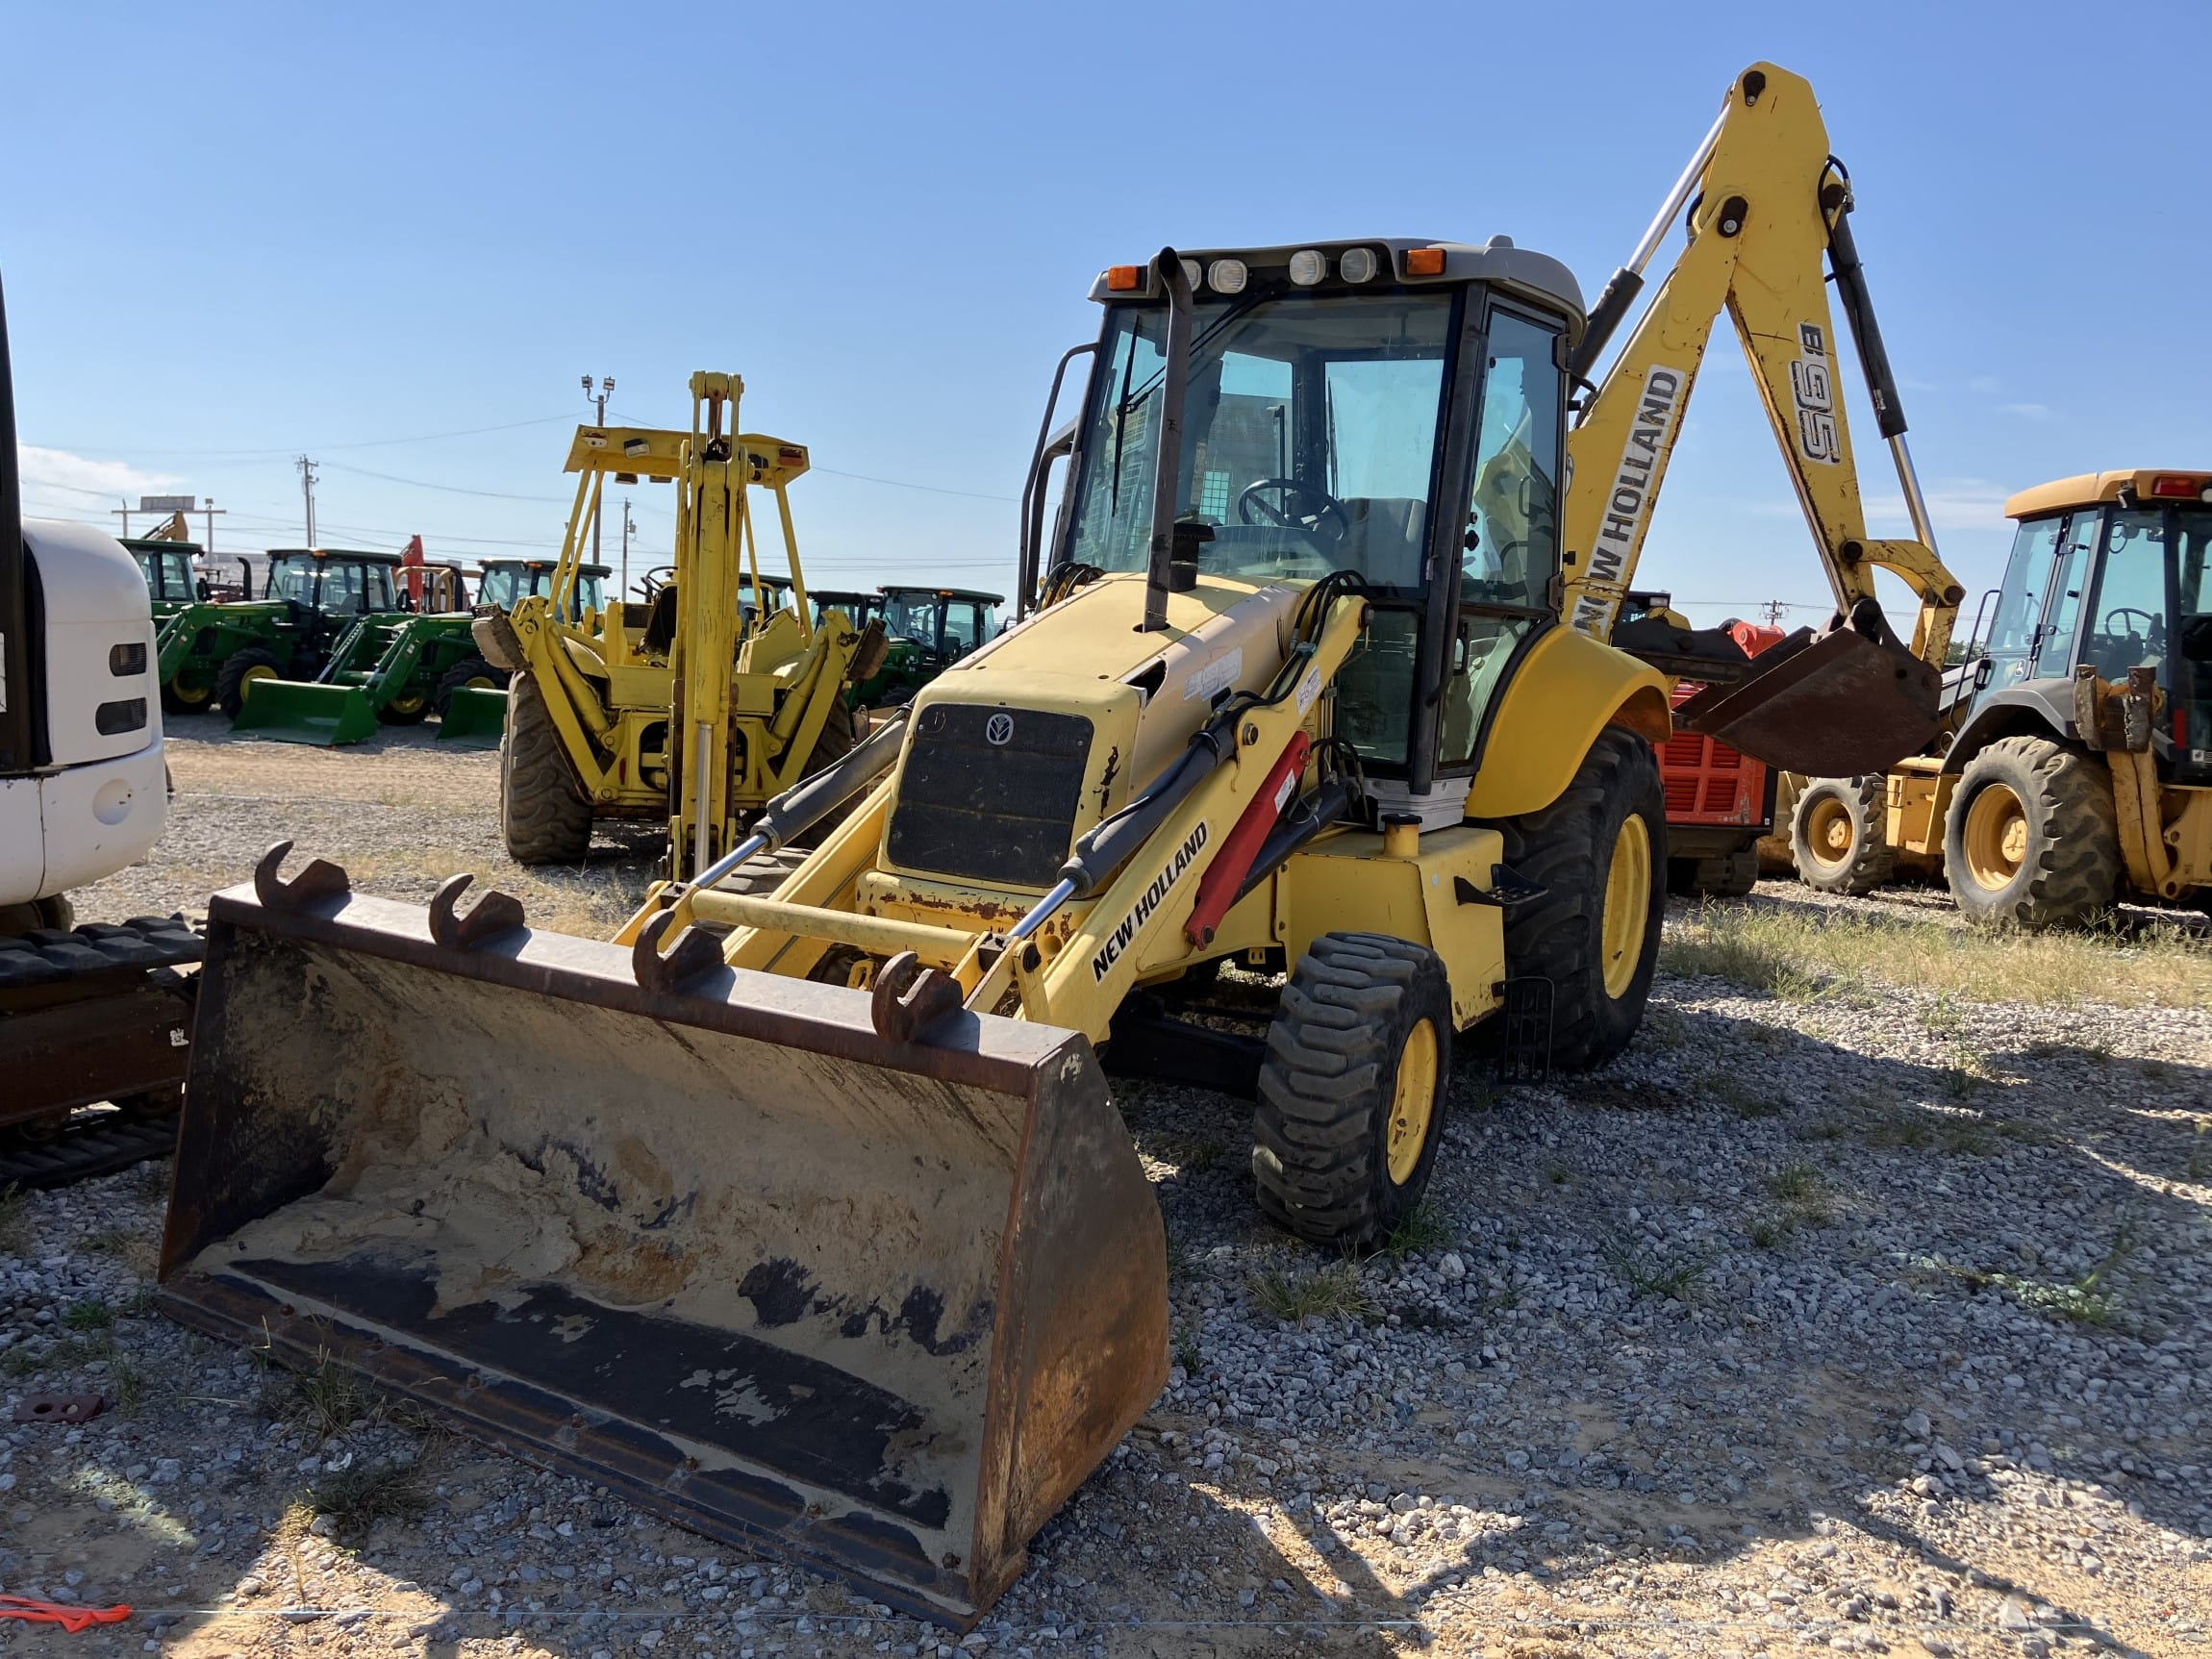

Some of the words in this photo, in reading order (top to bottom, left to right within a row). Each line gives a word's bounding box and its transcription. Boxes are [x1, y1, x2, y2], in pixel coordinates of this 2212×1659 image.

[1601, 371, 1678, 542] HOLLAND
[1093, 914, 1133, 982] NEW
[1134, 821, 1207, 928] HOLLAND
